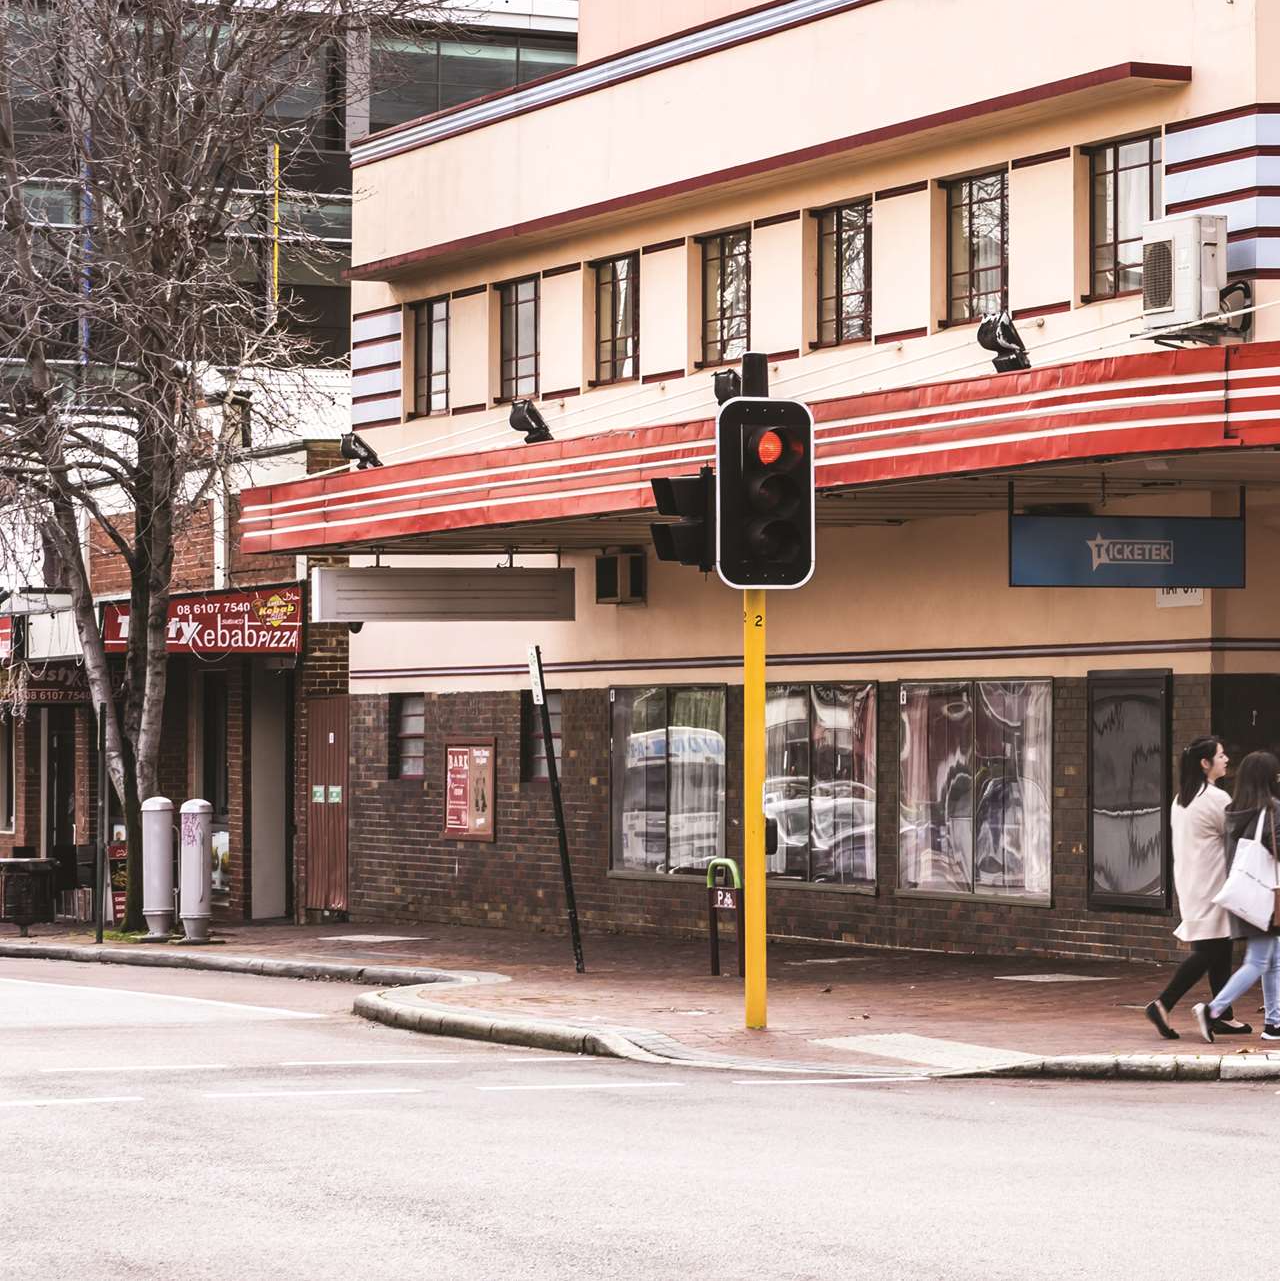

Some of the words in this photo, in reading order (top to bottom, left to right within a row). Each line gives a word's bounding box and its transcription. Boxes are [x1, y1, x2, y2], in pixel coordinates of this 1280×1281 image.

[1094, 542, 1171, 560] TICKETEK
[177, 604, 190, 615] 08
[194, 603, 220, 614] 6107
[224, 601, 250, 613] 7540
[755, 615, 763, 627] 2
[117, 615, 201, 645] Tty
[257, 630, 298, 648] PIZZA
[717, 890, 724, 906] P
